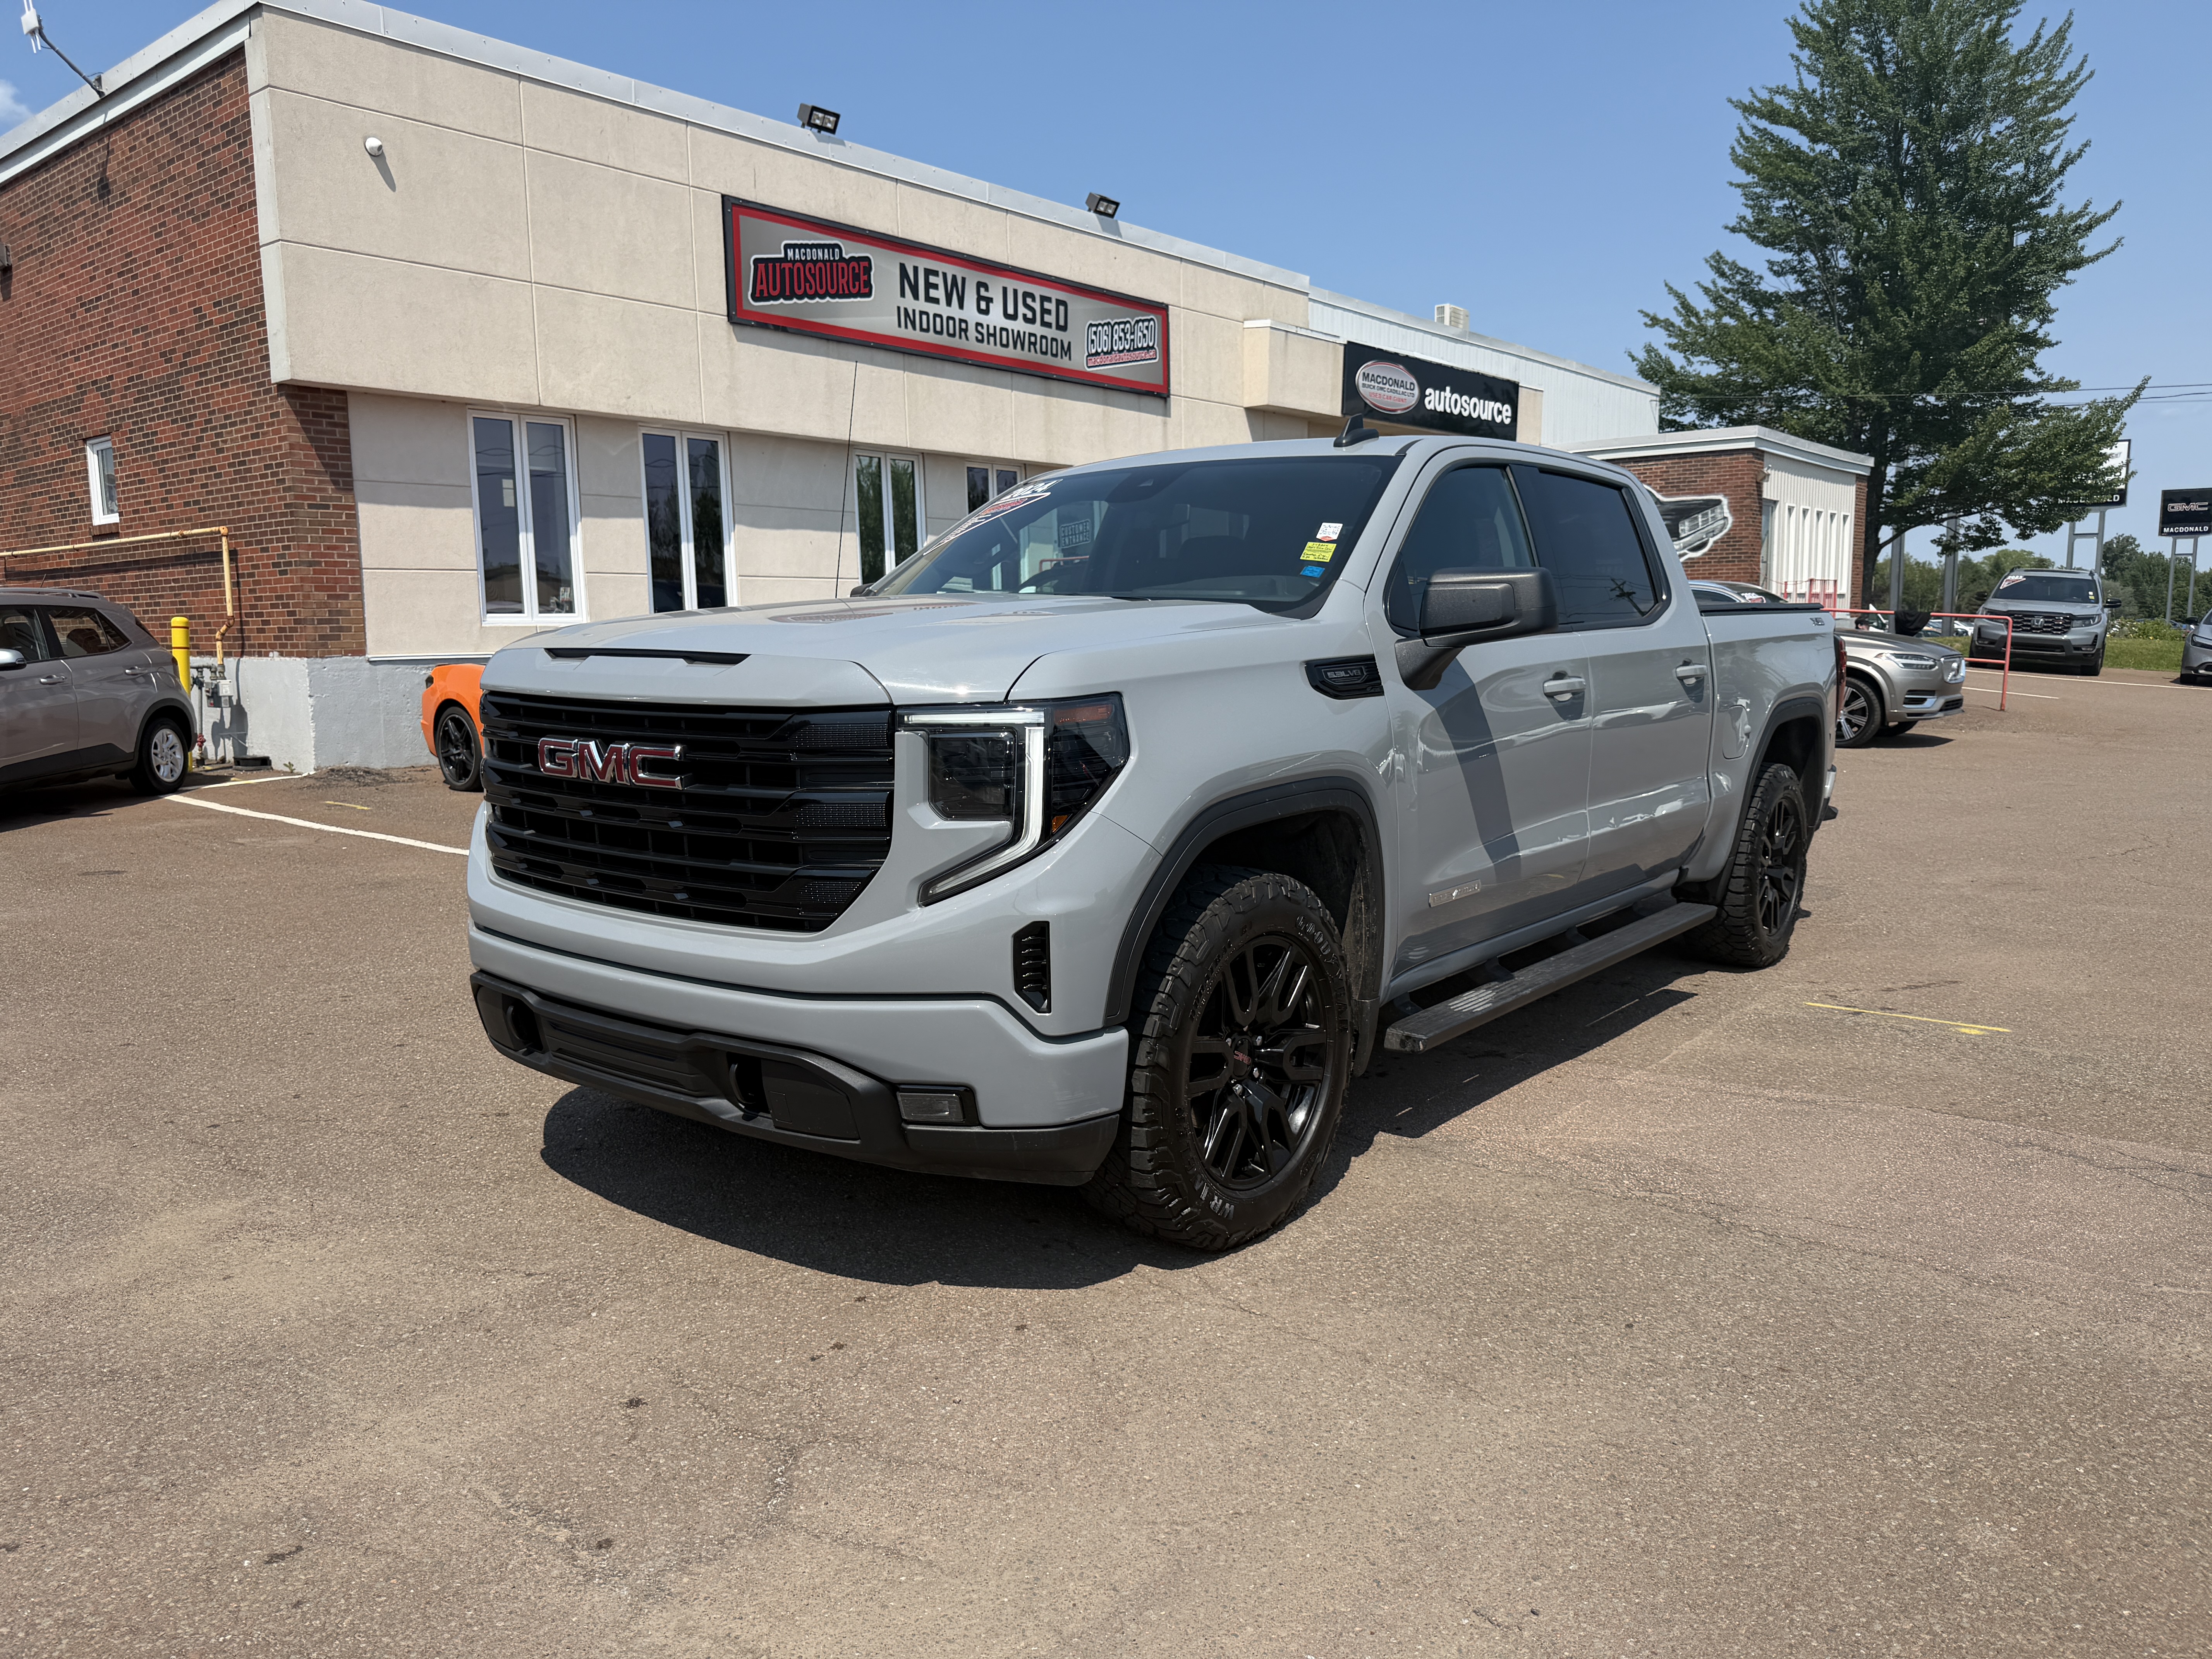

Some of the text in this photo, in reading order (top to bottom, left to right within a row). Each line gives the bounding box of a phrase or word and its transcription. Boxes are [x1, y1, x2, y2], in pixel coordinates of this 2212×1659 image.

[787, 248, 840, 261] MACDONALD
[756, 261, 870, 297] AUTOSOURCE
[899, 262, 1068, 332] NEW & USED
[897, 306, 1072, 361] INDOOR SHOWROOM
[1088, 321, 1154, 354] (506) 853-1650
[1362, 372, 1415, 391] MACDONALD
[1387, 388, 1407, 396] CADILLAC
[1424, 386, 1512, 424] autosource
[2167, 502, 2208, 512] GMC
[538, 737, 684, 790] GMC
[1233, 1051, 1252, 1065] GMC
